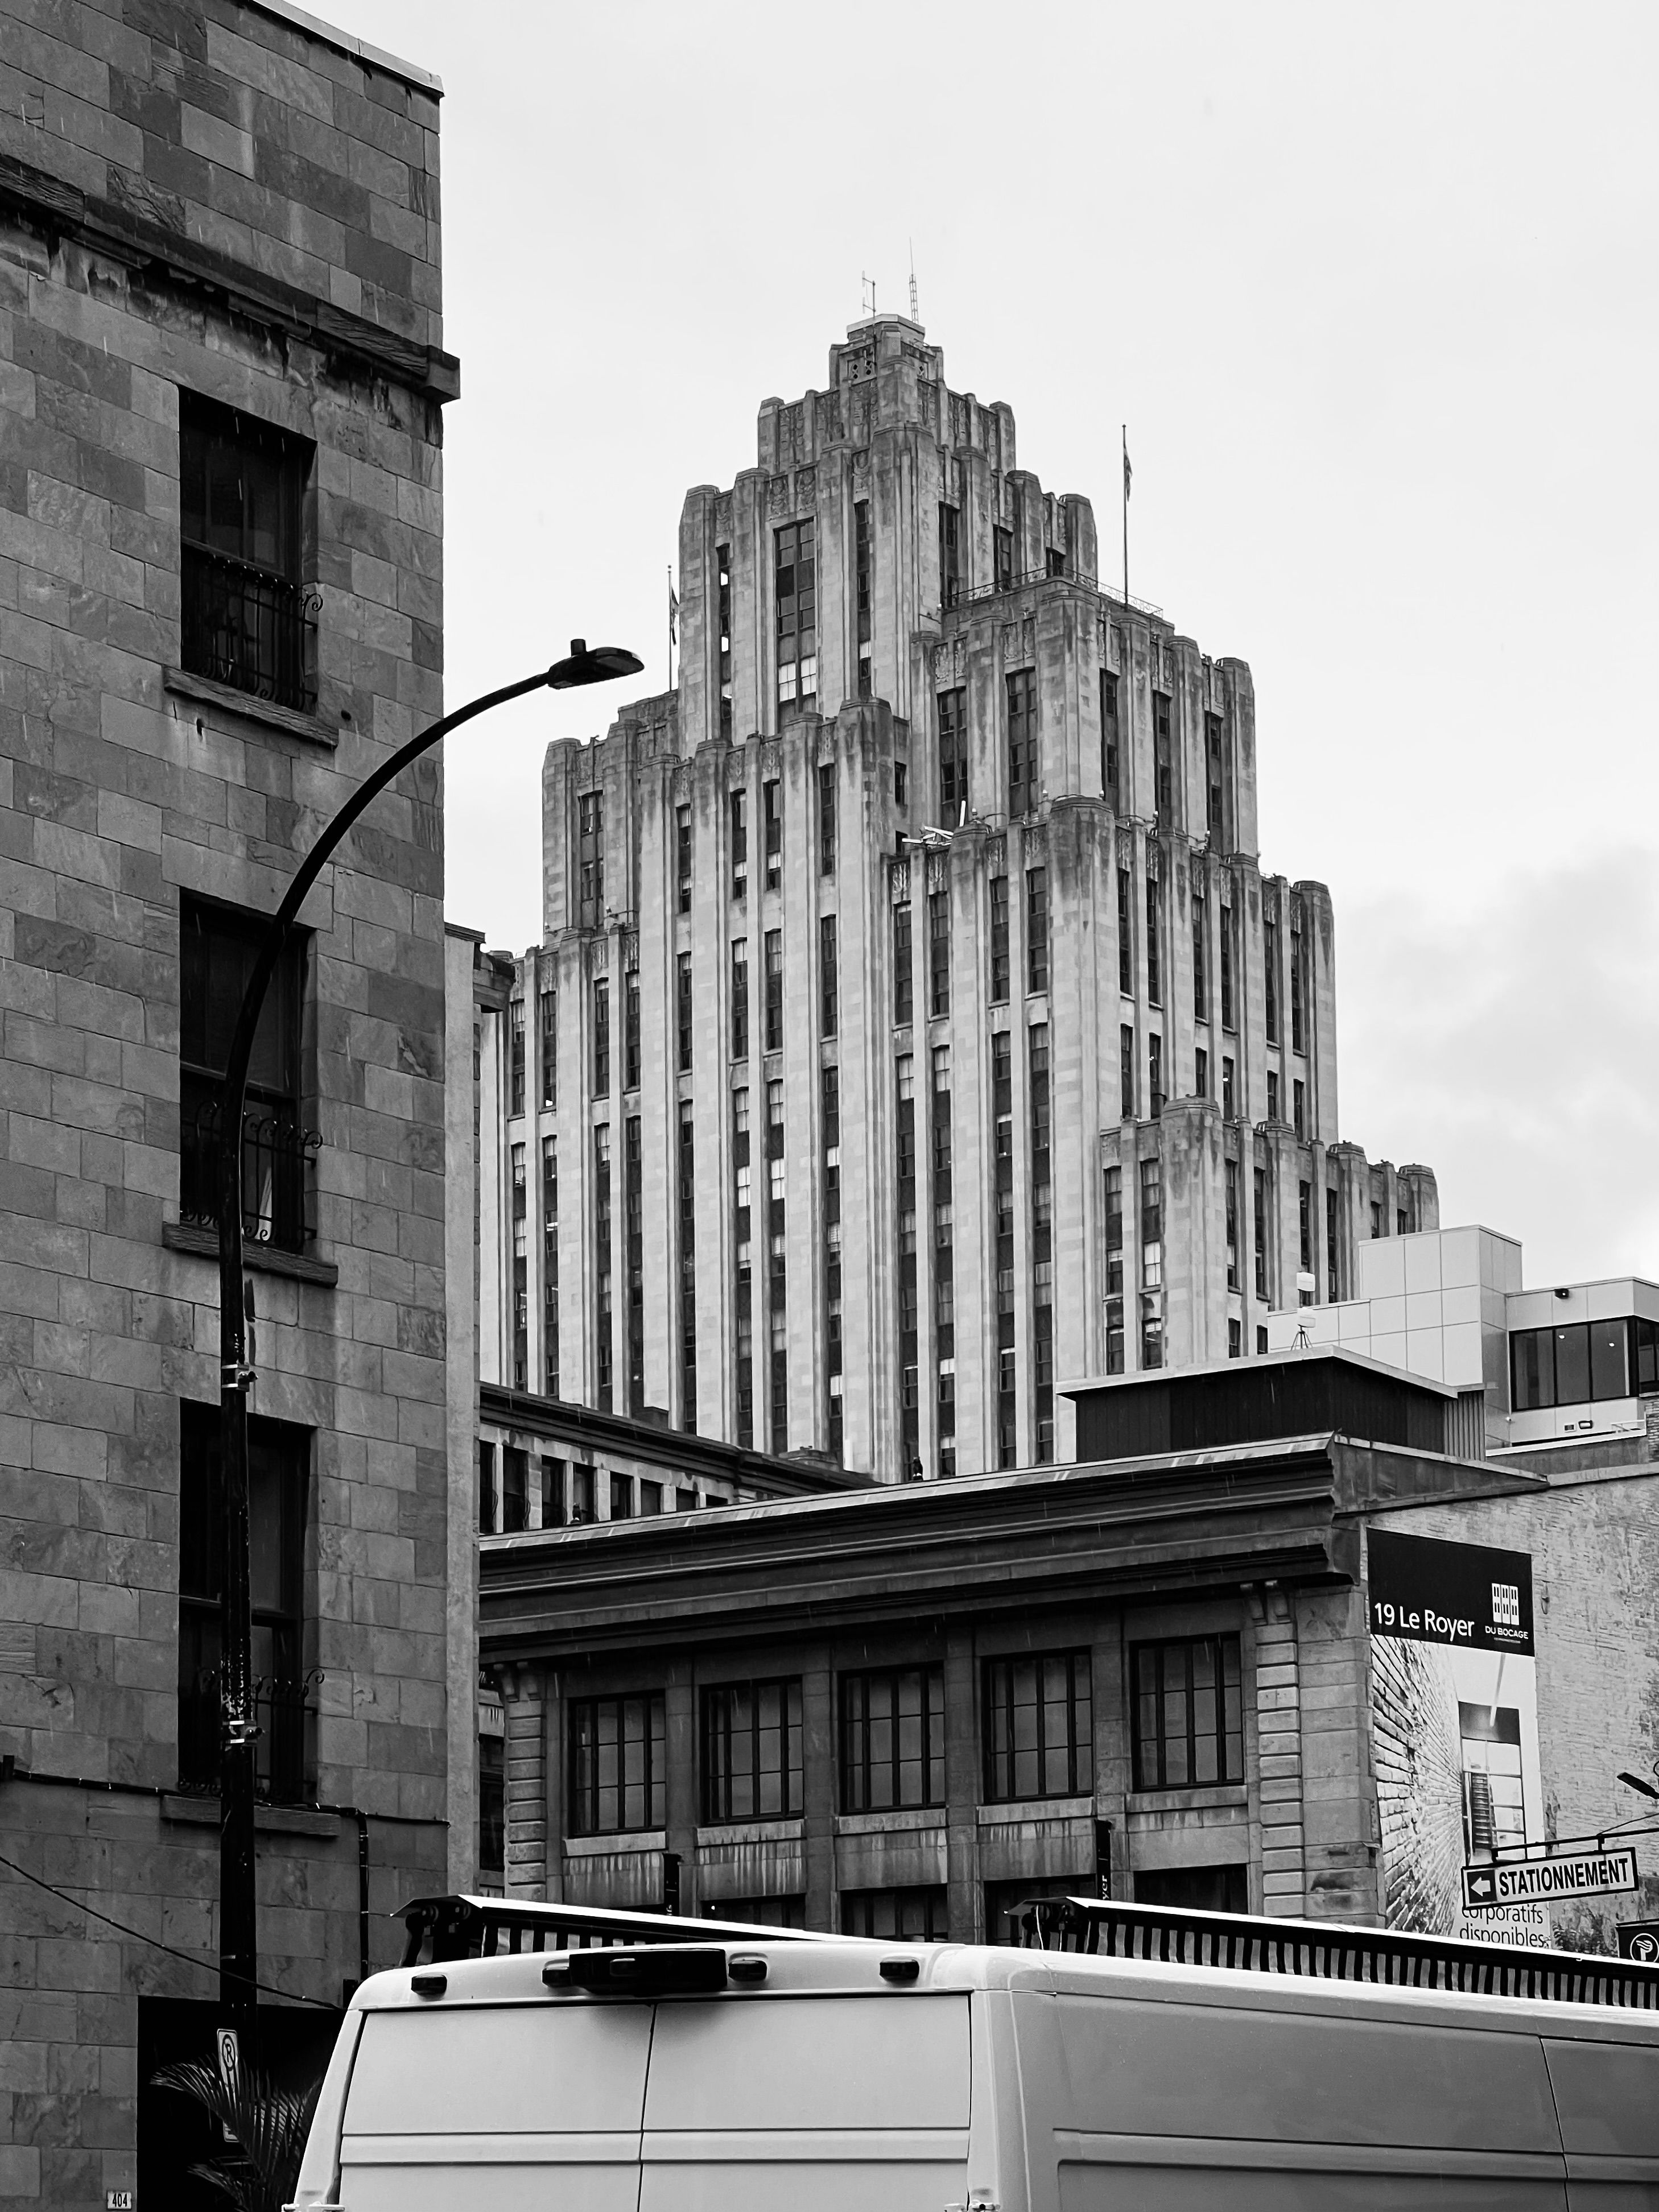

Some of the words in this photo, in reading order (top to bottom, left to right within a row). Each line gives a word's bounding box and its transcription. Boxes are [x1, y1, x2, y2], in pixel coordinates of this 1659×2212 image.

[1375, 1602, 1394, 1626] 19
[1400, 1606, 1420, 1629] Le
[1424, 1609, 1475, 1642] Royer
[1485, 1626, 1496, 1635] DU
[1497, 1627, 1529, 1640] BOCAGE
[1101, 1875, 1110, 1900] yer
[1499, 1858, 1628, 1896] STATIONNEMENT
[112, 2193, 127, 2207] 404
